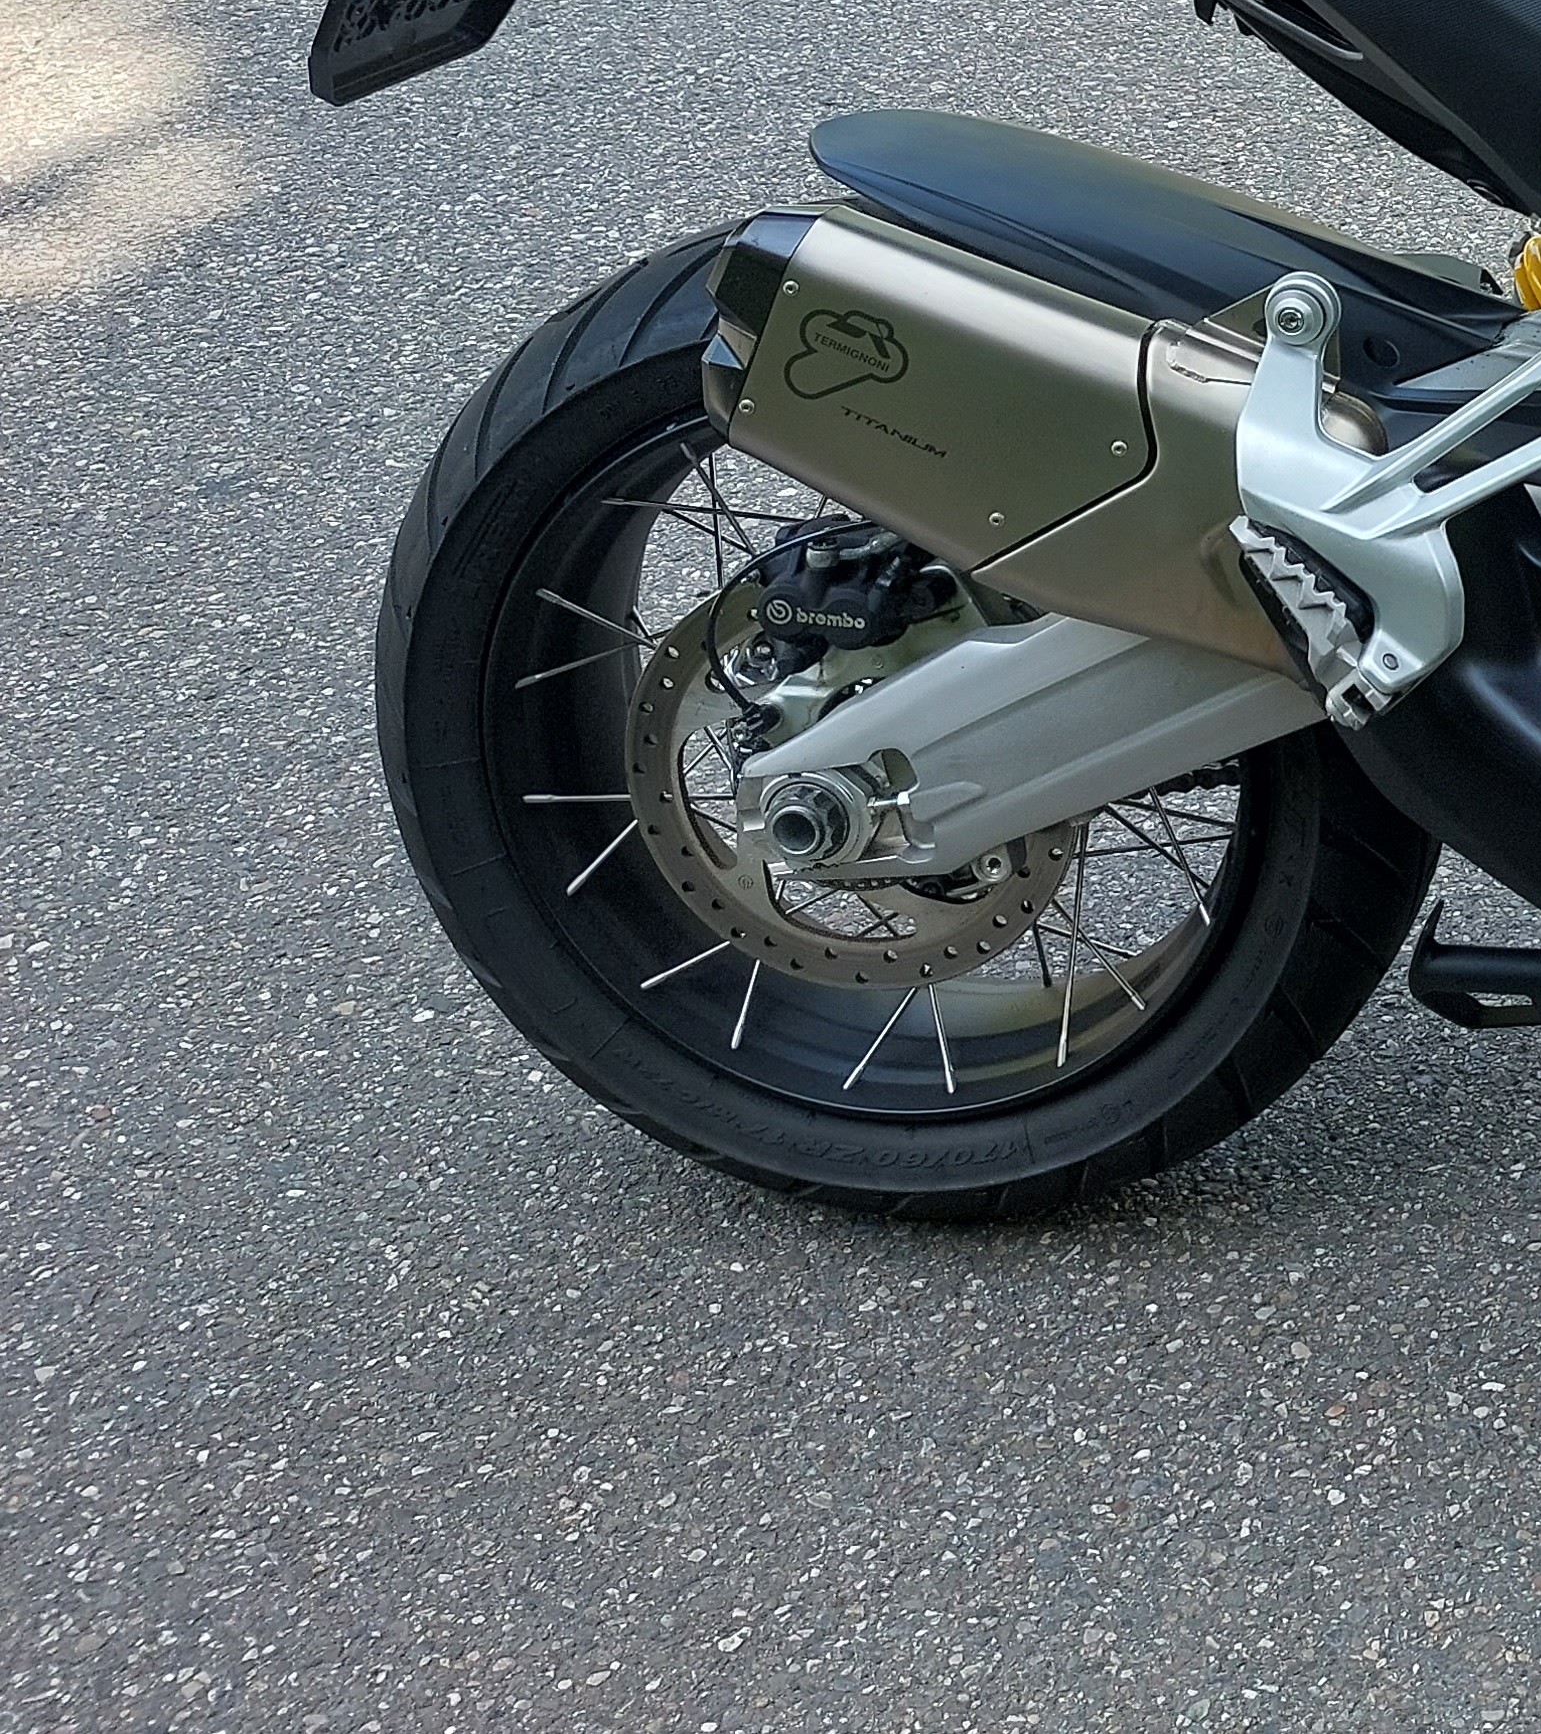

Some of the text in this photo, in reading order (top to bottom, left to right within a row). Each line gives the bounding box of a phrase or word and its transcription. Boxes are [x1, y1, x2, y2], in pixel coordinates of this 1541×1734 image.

[814, 332, 890, 373] TERMIGNONI
[841, 405, 947, 458] TITANIUM
[796, 606, 866, 629] brembo
